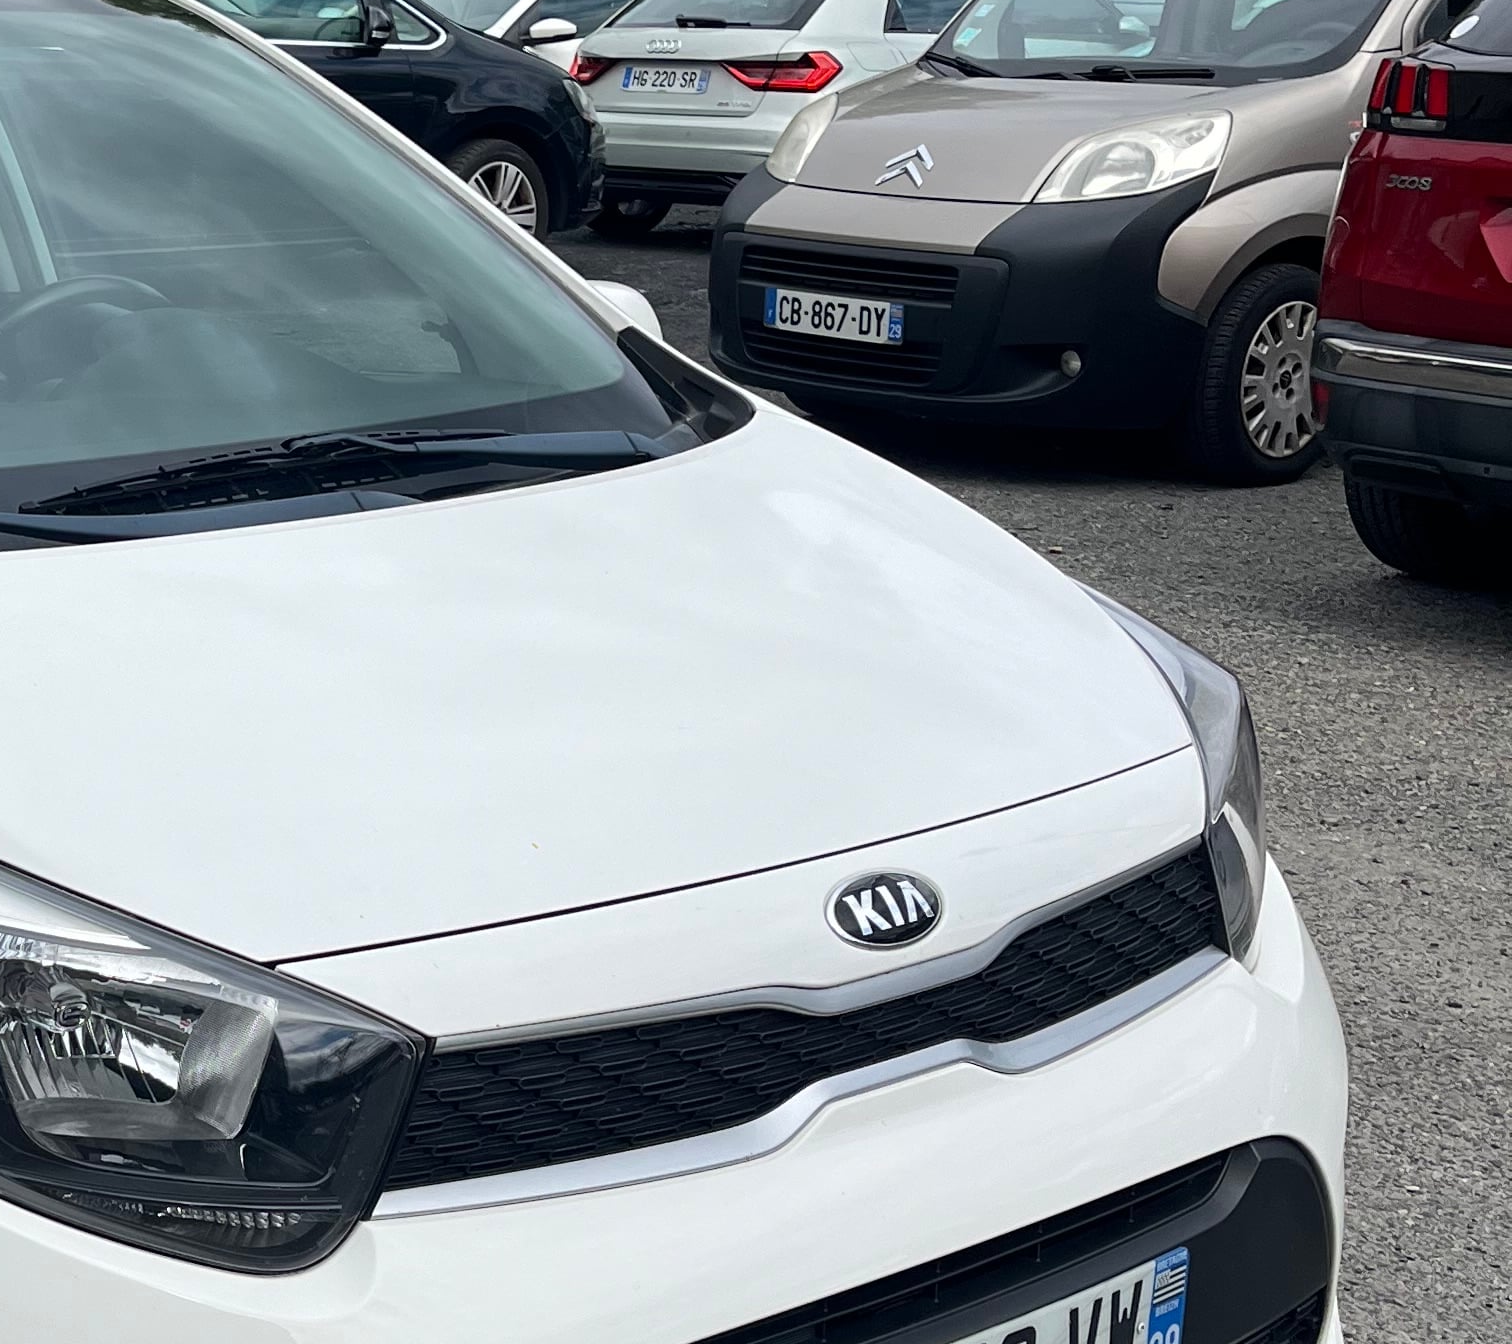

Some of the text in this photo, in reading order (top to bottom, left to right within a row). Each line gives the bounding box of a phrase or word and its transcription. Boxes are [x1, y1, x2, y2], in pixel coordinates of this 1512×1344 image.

[779, 295, 886, 338] CB-867-DY
[888, 323, 902, 339] 29
[841, 880, 935, 936] KIA
